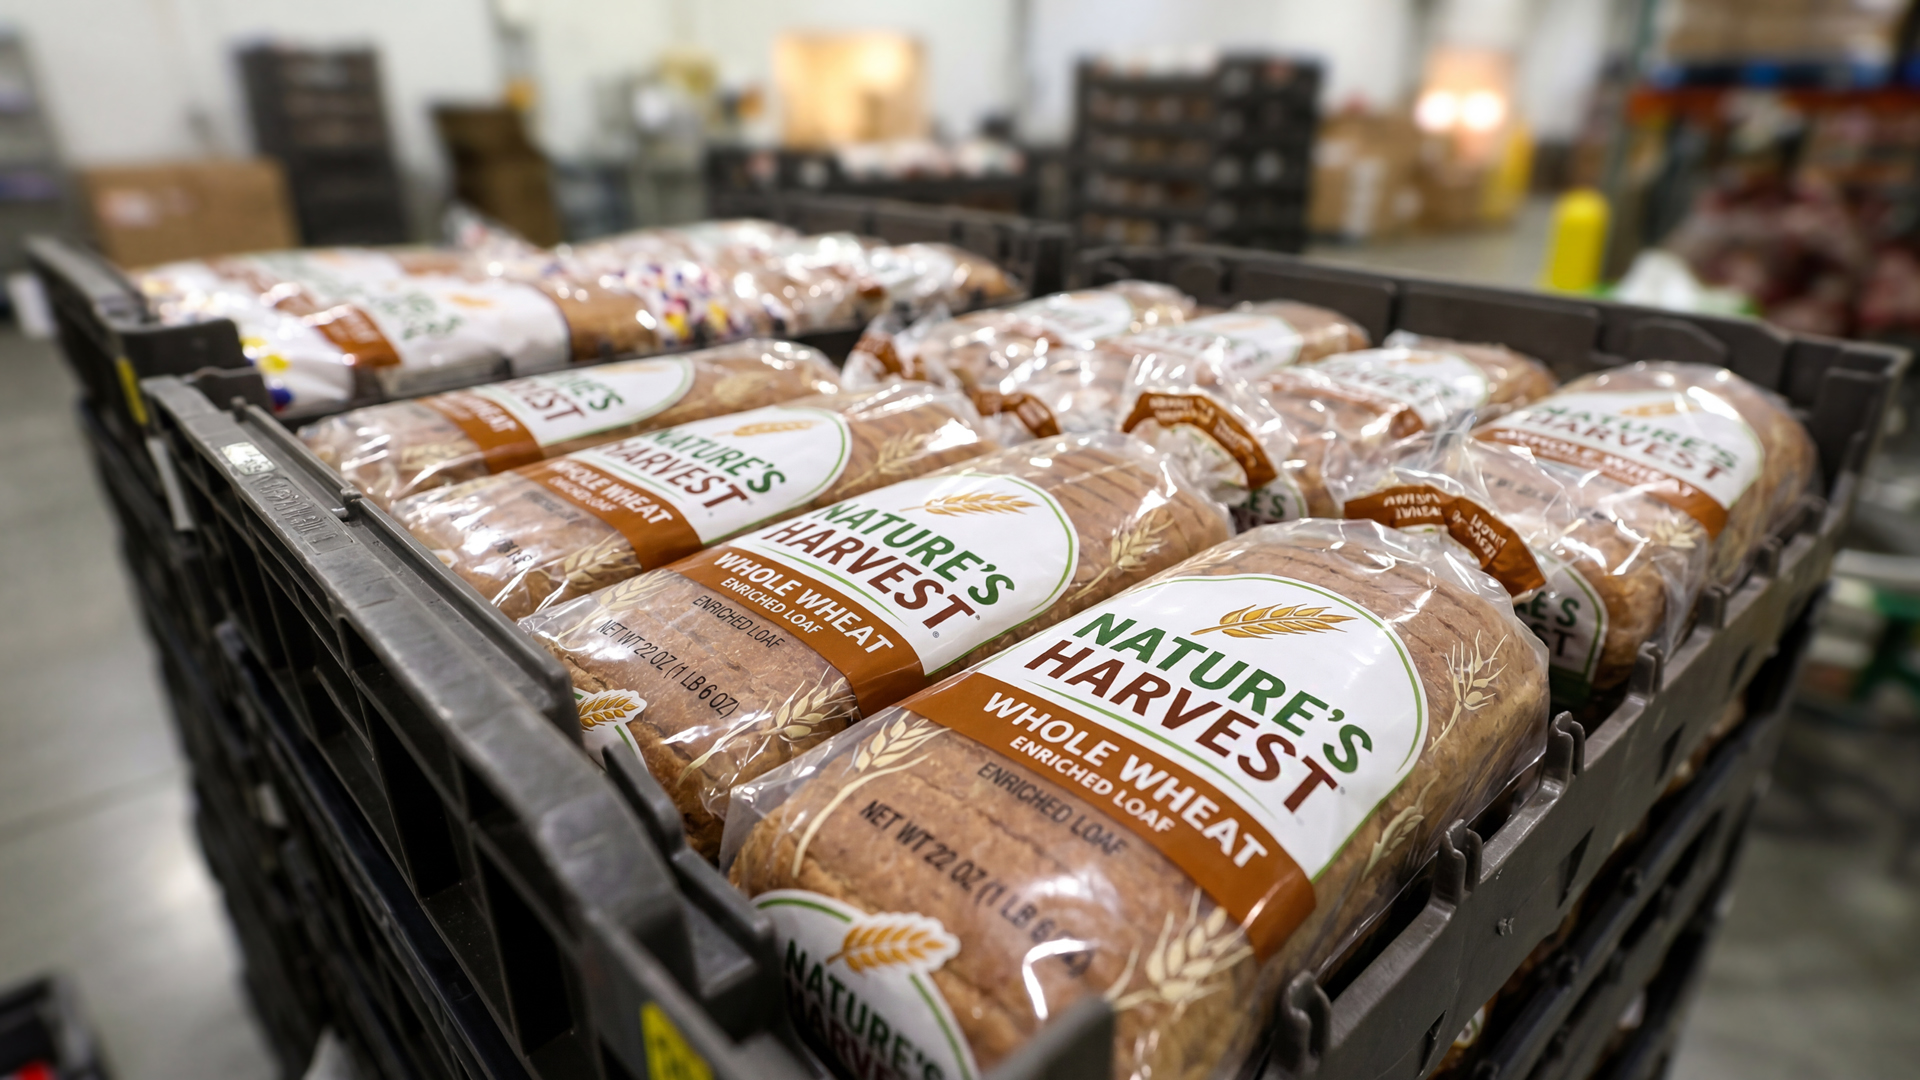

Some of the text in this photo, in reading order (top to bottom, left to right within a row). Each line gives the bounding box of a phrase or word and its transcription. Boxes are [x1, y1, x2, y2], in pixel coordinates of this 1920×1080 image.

[594, 438, 749, 509] HARVEST
[600, 483, 674, 524] WHEAT
[640, 428, 786, 494] NATURE'S
[713, 551, 895, 654] WHOLE WHEAT
[761, 521, 976, 630] HARVEST
[811, 503, 1015, 606] NATURE'S
[692, 595, 786, 649] ENRICHED LOAF
[720, 577, 824, 634] ENRICHED LOAF
[597, 619, 741, 720] NET WT 22 OZ (1 LB 6 OZ)
[1073, 612, 1373, 775] NATURE'S
[1024, 640, 1339, 814] HARVEST
[976, 761, 1130, 856] ENRICHED LOAF
[982, 691, 1269, 869] WHOLE WHEAT
[1009, 735, 1176, 833] ENRICHED LOAF
[859, 799, 904, 831] NET
[896, 820, 936, 853] WT
[924, 842, 958, 873] 22
[950, 860, 988, 892] OZ
[1000, 895, 1039, 929] LB
